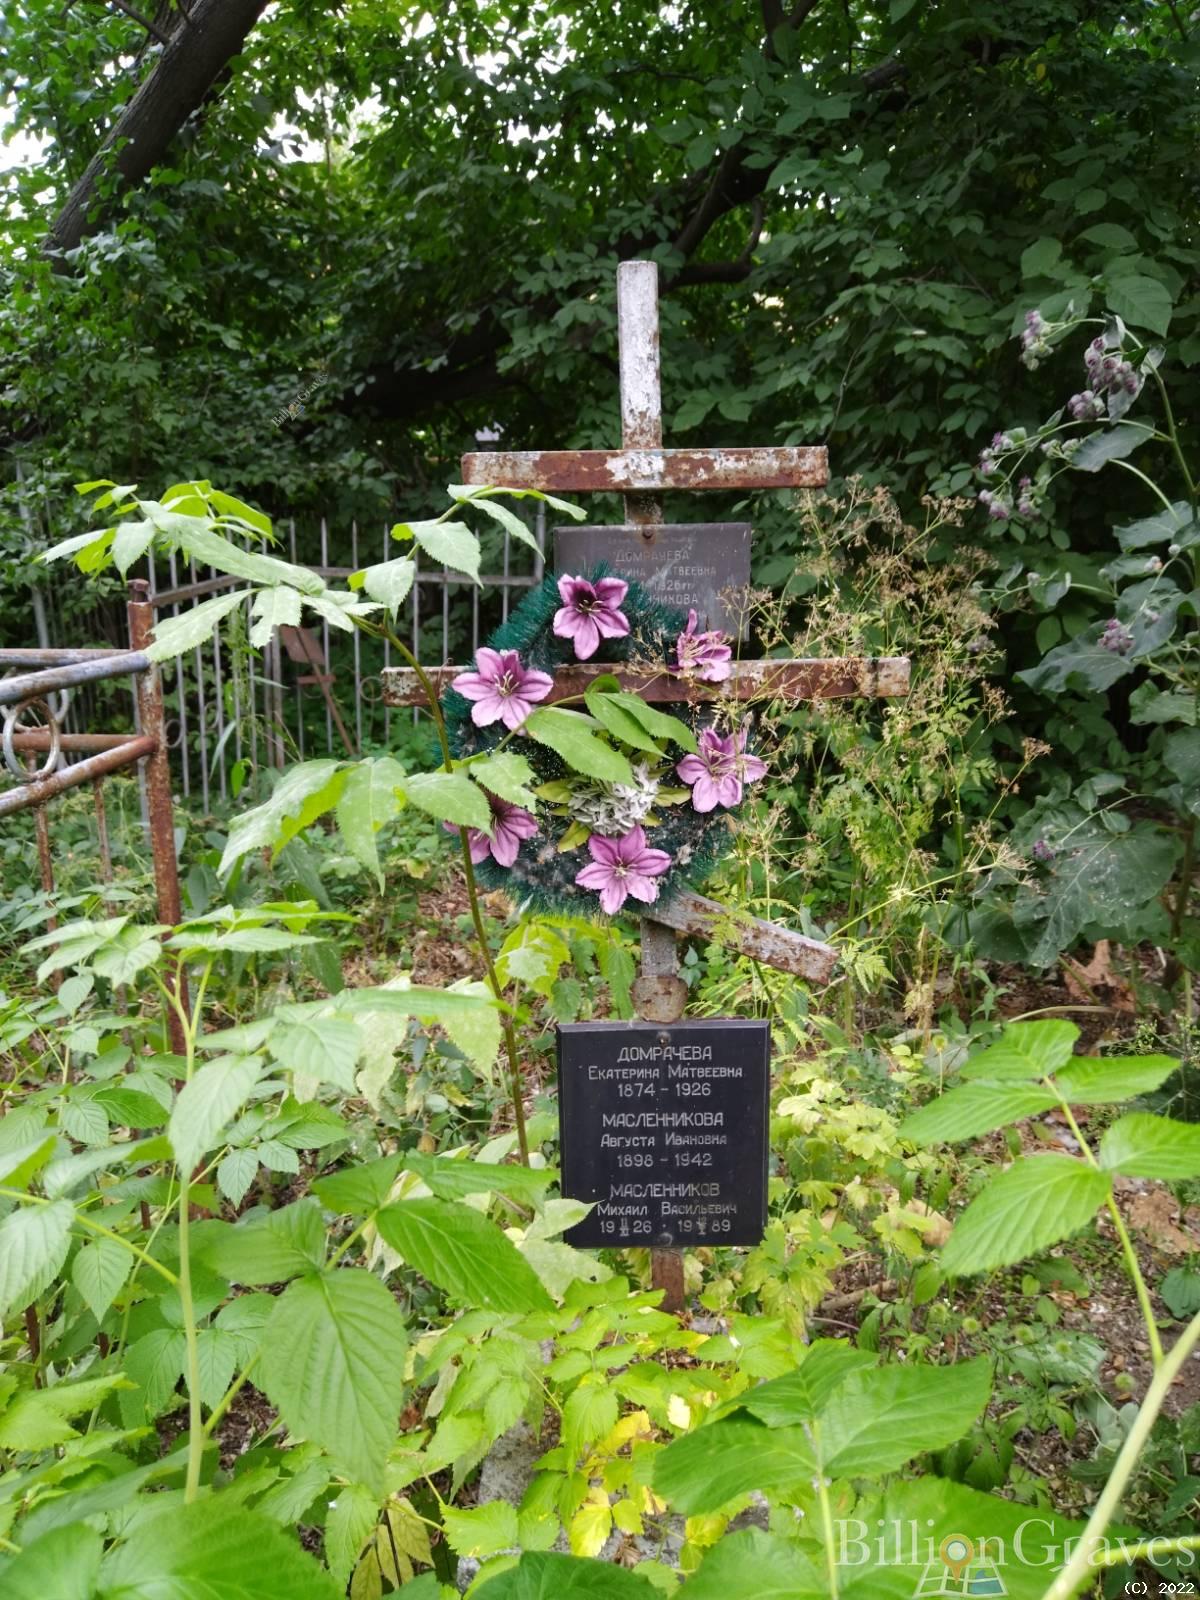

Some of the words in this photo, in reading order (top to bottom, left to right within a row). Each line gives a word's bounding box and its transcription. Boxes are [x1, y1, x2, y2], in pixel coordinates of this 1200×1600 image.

[616, 1046, 713, 1063] ДОМРАЧЕВА
[618, 1084, 656, 1097] 1874
[676, 1083, 711, 1096] 1926
[602, 1112, 724, 1128] МАСЛЕННИКОВА
[617, 1154, 654, 1168] 1898
[675, 1153, 713, 1167] 1942
[610, 1183, 721, 1199] МАСЛЕННИКОВ
